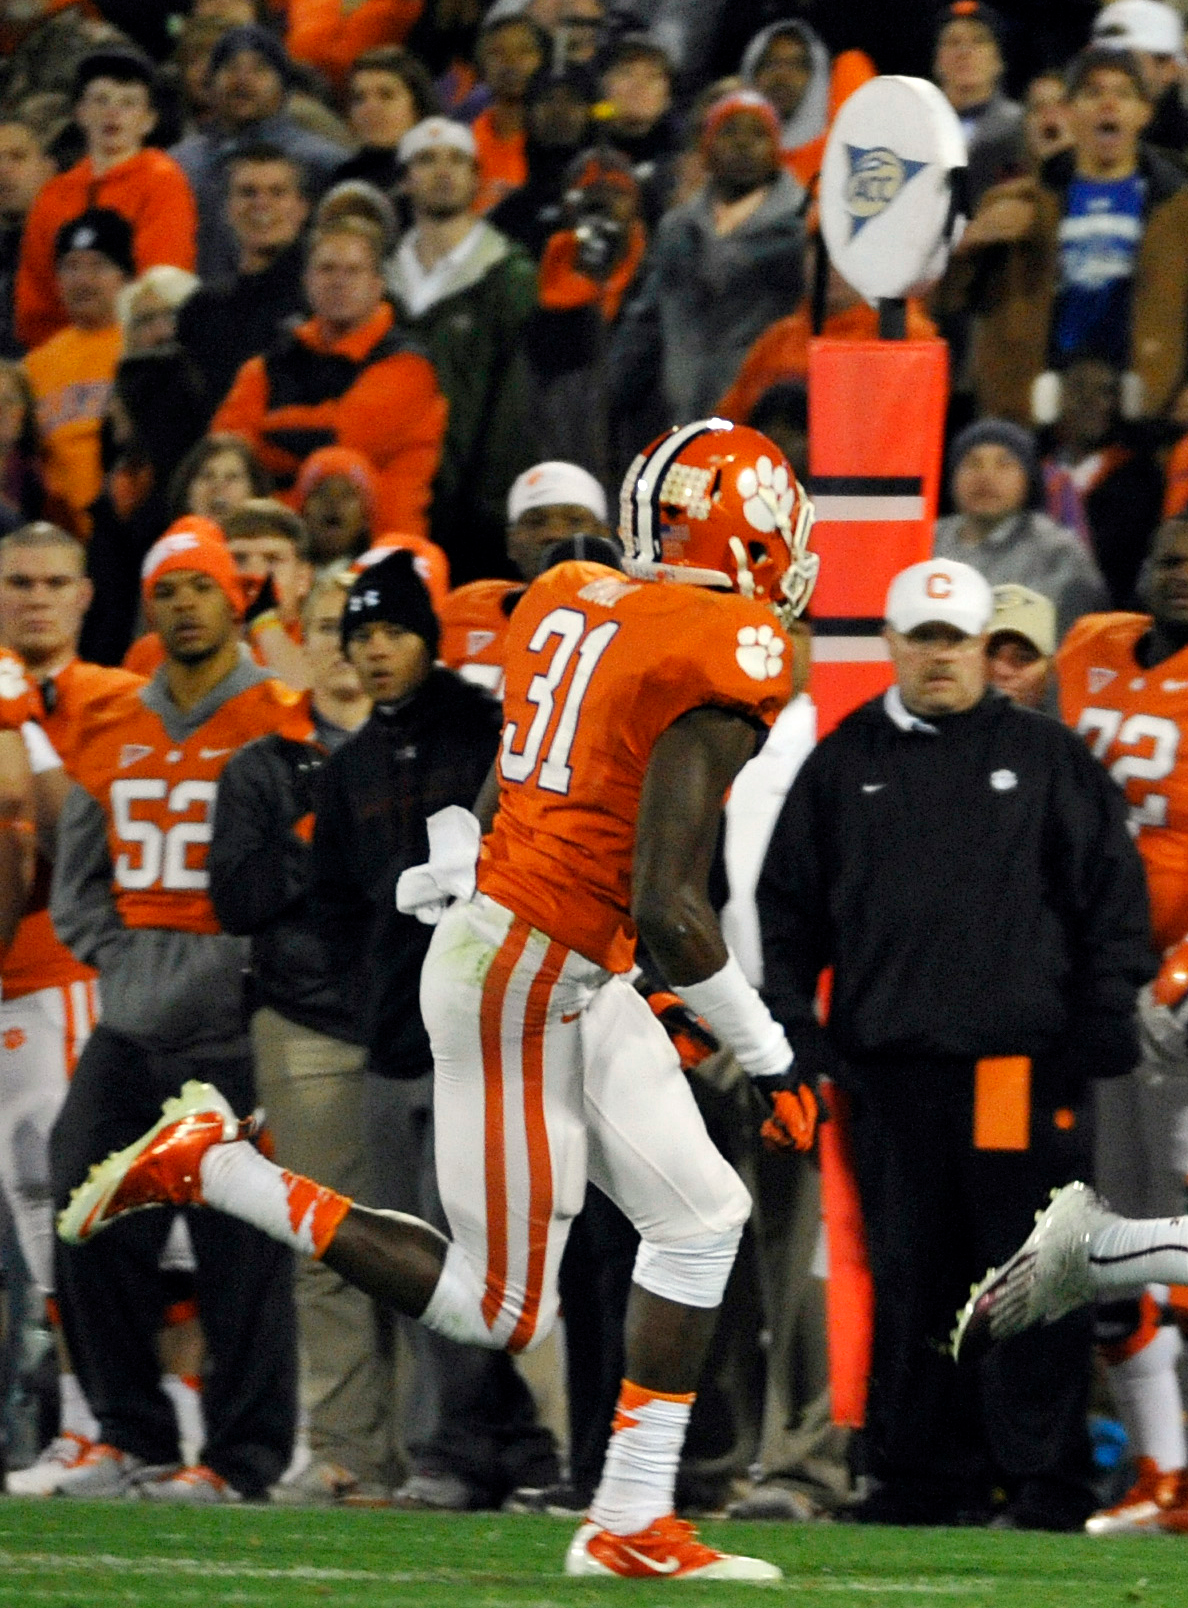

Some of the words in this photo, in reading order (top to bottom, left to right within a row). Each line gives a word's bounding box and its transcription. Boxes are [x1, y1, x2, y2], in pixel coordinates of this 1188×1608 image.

[925, 572, 953, 600] C
[500, 606, 621, 796] 31
[110, 778, 219, 890] 52
